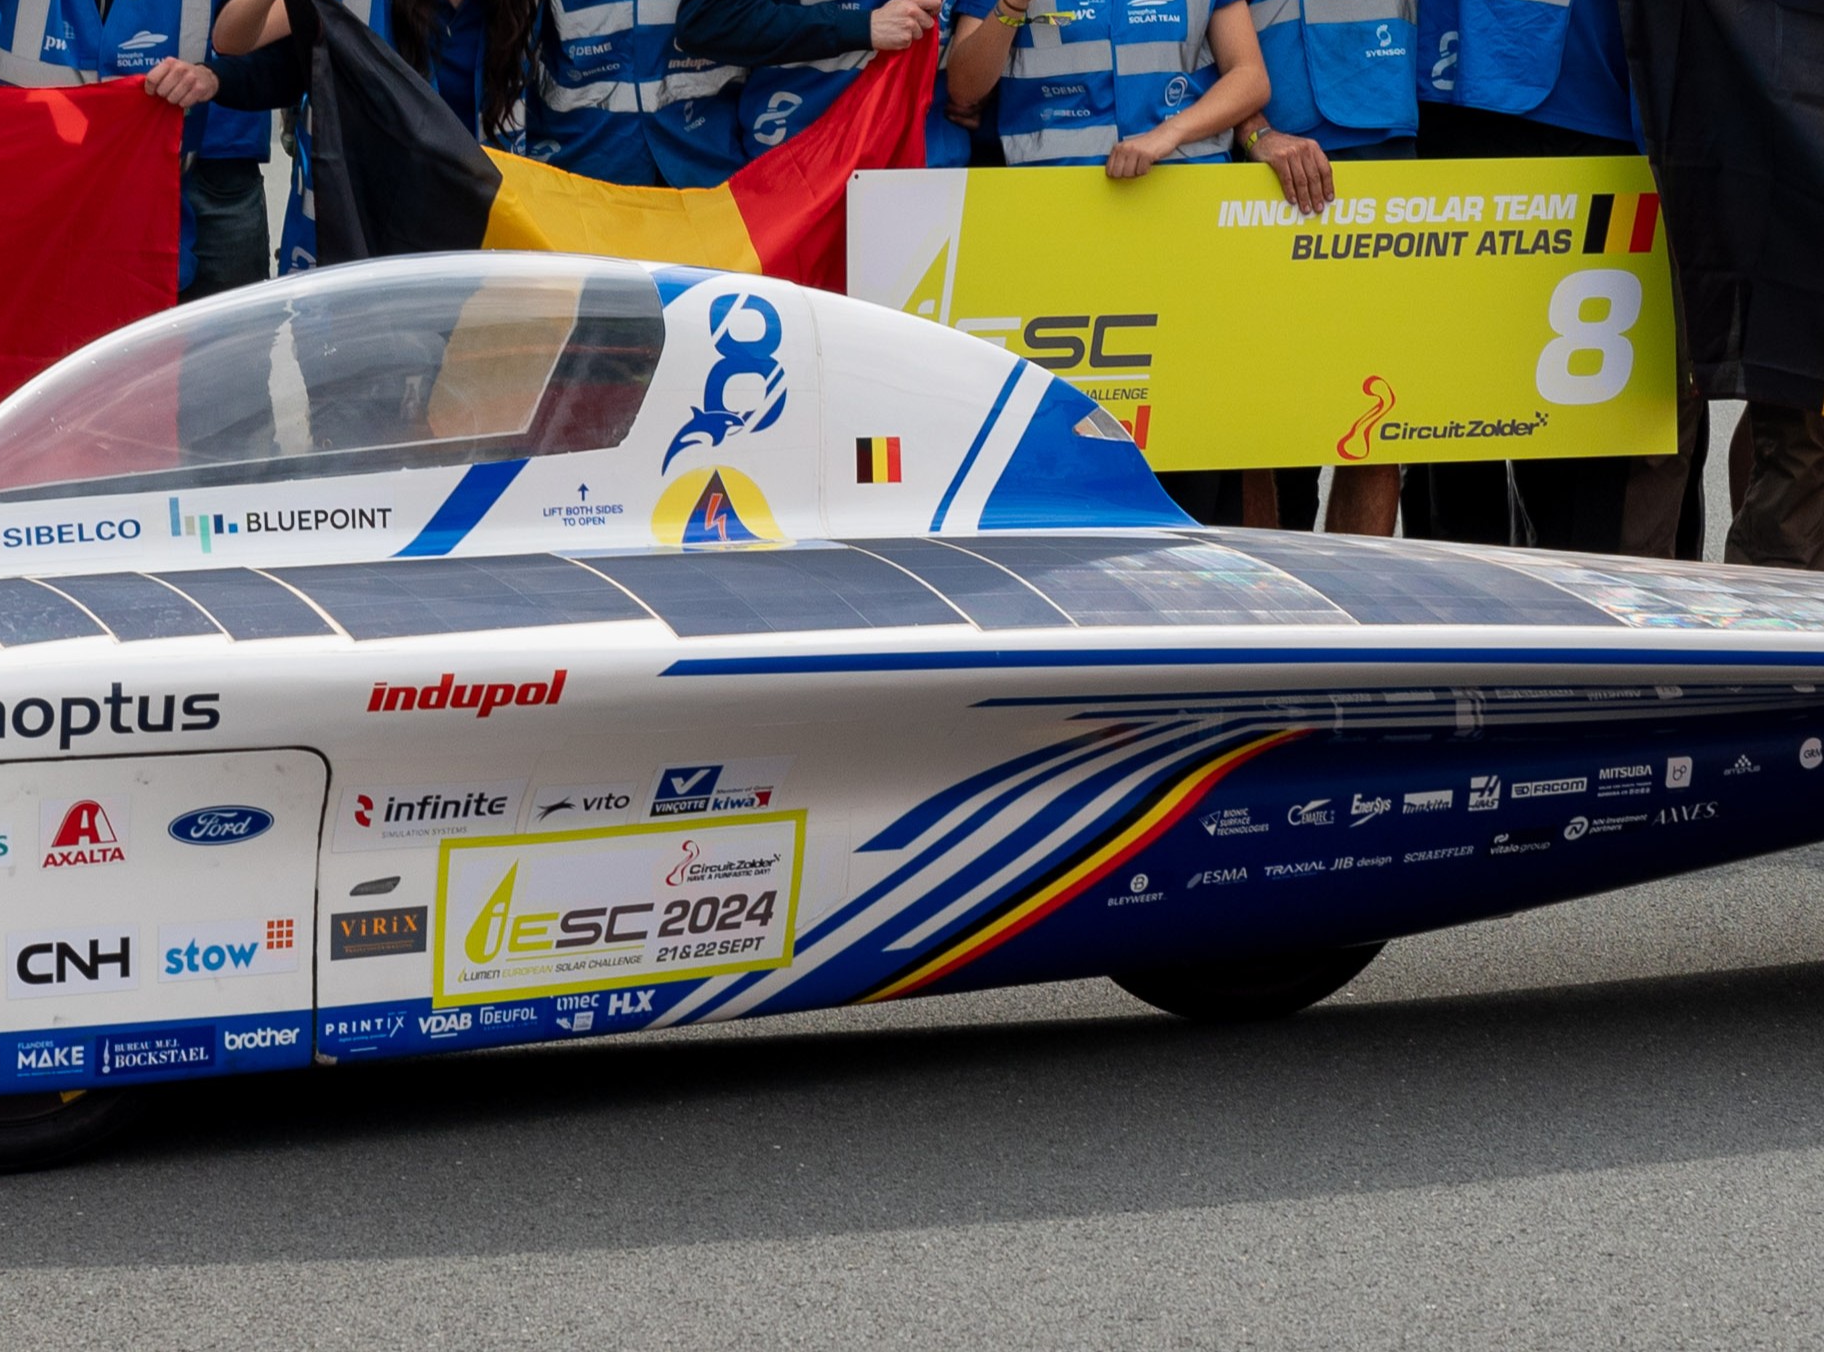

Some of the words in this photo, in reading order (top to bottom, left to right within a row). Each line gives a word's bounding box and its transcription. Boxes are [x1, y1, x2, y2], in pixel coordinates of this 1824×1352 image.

[1129, 14, 1157, 24] SOLAR
[1158, 14, 1181, 23] TEAM
[1384, 195, 1484, 223] SOLAR
[1492, 193, 1577, 221] TEAM
[1291, 230, 1468, 261] BLUEPOINT
[1475, 228, 1572, 256] ATLAS
[1535, 268, 1643, 405] 8
[1086, 388, 1149, 401] ALLENGE
[1380, 412, 1539, 441] CircuitZolder
[246, 508, 392, 534] BLUEPOINT
[543, 507, 563, 518] LIFT
[565, 505, 594, 516] BOTH
[596, 504, 623, 515] SIDES
[562, 517, 576, 527] TO
[578, 516, 605, 527] OPEN
[2, 517, 142, 549] SIBELCO
[366, 669, 568, 718] indupol
[1599, 765, 1652, 780] MITSUBA
[1533, 779, 1586, 795] FACOM
[384, 792, 508, 822] infinite
[582, 793, 630, 811] vito
[655, 799, 707, 814] VINÇOTTE
[712, 795, 756, 811] kiwa
[1351, 793, 1391, 815] EnerSys
[1220, 816, 1251, 826] SURFACE
[1223, 808, 1249, 818] BIONIC
[190, 810, 250, 839] Ford
[381, 829, 429, 839] SIMULATION
[432, 826, 467, 836] SYSTEMS
[1216, 823, 1270, 836] TECHNOLOGIES
[42, 847, 125, 868] AXALTA
[1330, 856, 1354, 871] JIB
[1357, 855, 1392, 868] design
[1404, 845, 1474, 863] SCHAEFFLER
[690, 857, 775, 876] CircuitZolder
[1202, 867, 1248, 885] ESMA
[1264, 860, 1326, 877] TRAXIAL
[687, 875, 706, 883] HAVE
[1107, 893, 1164, 907] BLEYWEERT
[658, 890, 778, 938] 2024
[340, 914, 418, 938] ViRiX
[165, 938, 258, 976] stow
[656, 947, 678, 963] 21
[694, 941, 717, 958] 22
[718, 936, 765, 955] SEPT
[16, 937, 130, 985] CNH
[502, 965, 554, 978] EUROPEAN
[555, 961, 586, 973] SOLAR
[587, 954, 643, 969] CHALLENGE
[608, 989, 656, 1016] HLX
[418, 1012, 472, 1034] VDAB
[485, 1008, 538, 1025] DEUFOL
[325, 1016, 405, 1038] PRINTIX
[17, 1041, 54, 1049] FLANDERS
[114, 1041, 152, 1053] BUREAU
[225, 1027, 300, 1050] brother
[17, 1045, 84, 1070] MAKE
[114, 1047, 209, 1069] BOCKSTAEL
